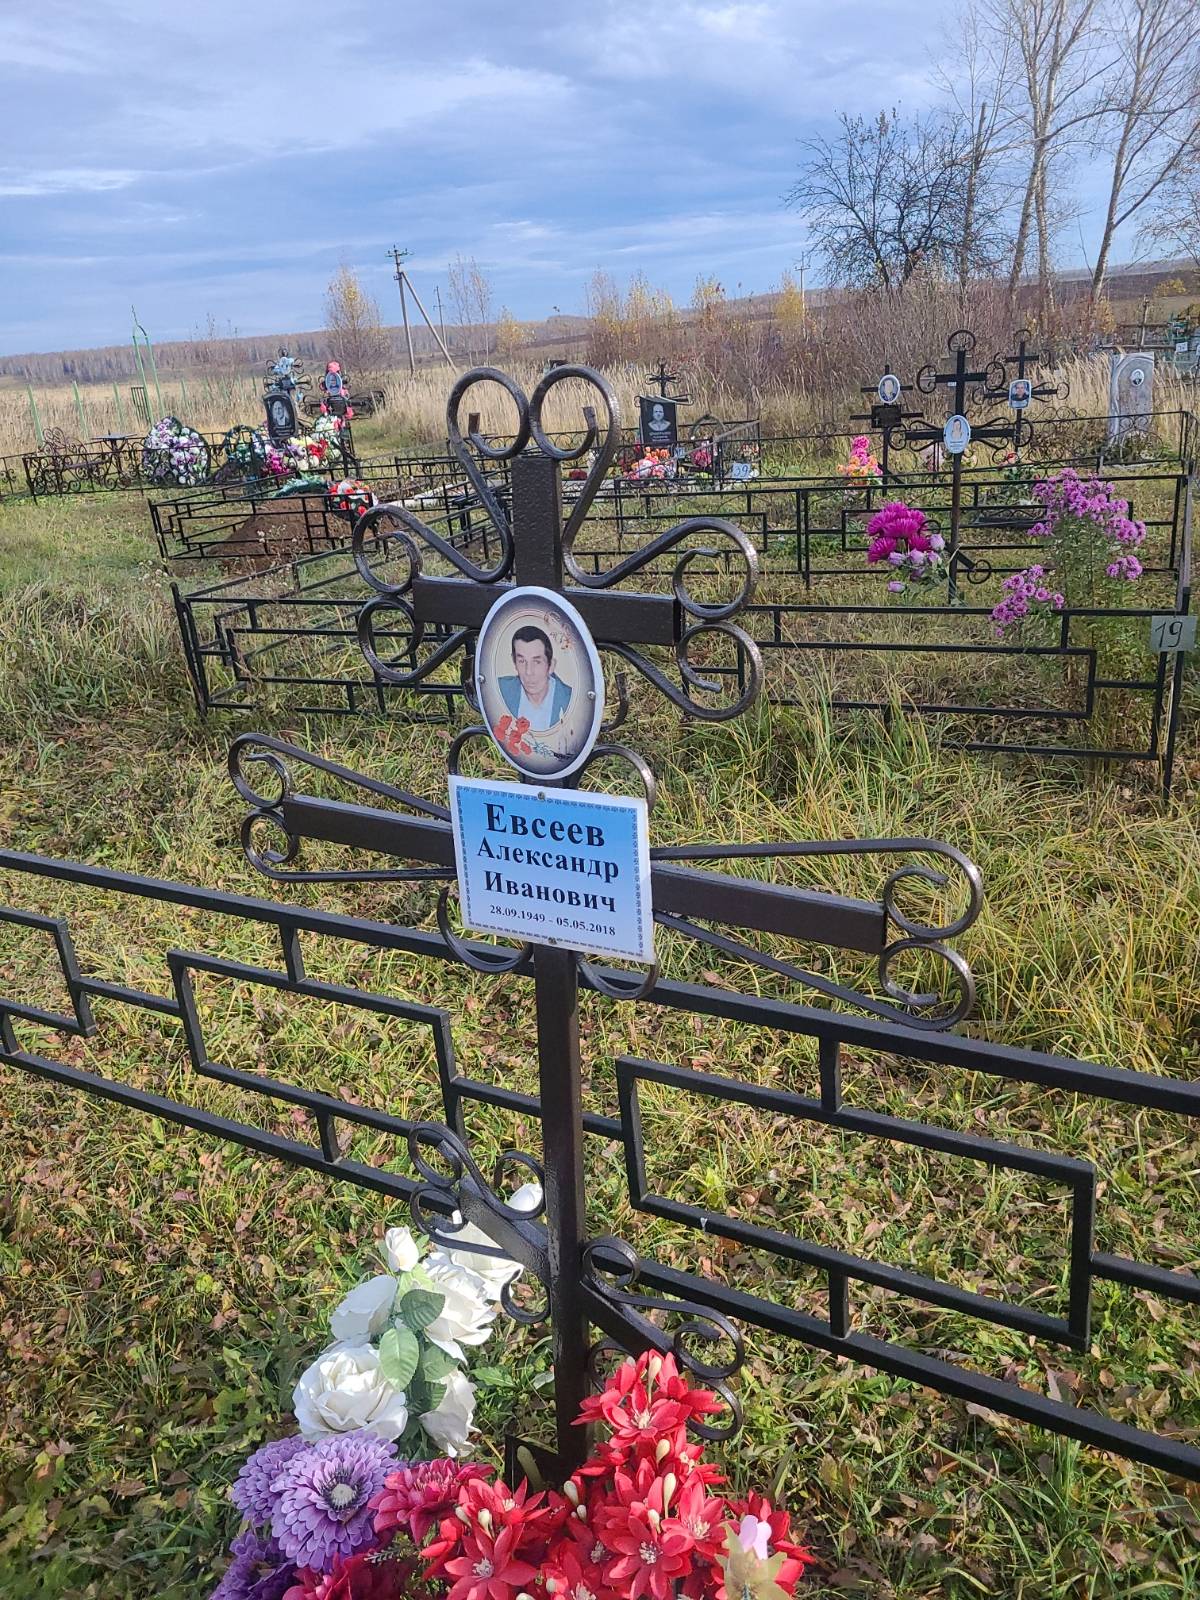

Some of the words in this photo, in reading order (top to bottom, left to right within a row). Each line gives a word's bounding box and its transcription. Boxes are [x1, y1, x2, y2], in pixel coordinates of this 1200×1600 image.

[1155, 621, 1183, 648] 19
[483, 802, 605, 847] Евсеев
[477, 836, 619, 884] Александр
[484, 870, 616, 913] Иванович
[490, 904, 546, 923] 28.09.1949
[556, 916, 616, 936] 05.05.2018
